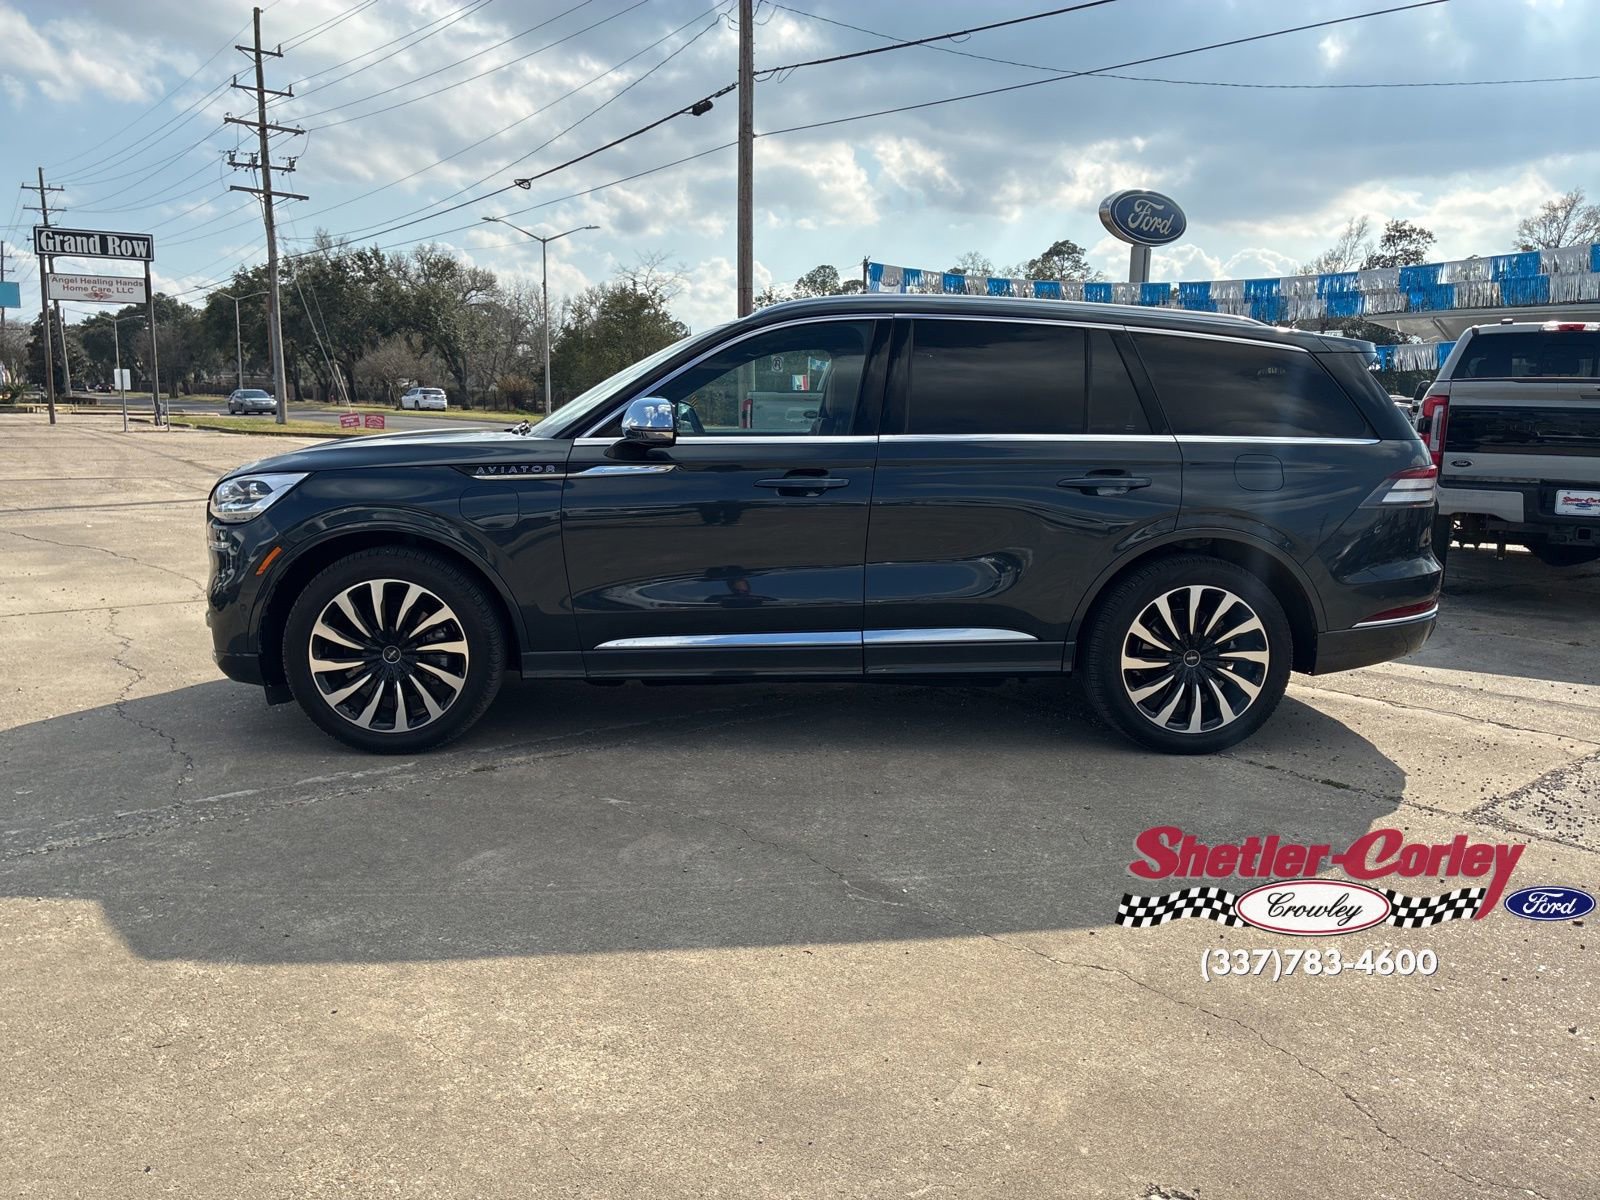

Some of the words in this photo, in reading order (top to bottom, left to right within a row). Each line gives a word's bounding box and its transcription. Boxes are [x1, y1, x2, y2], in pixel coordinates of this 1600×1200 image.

[1127, 199, 1175, 235] Ford
[40, 231, 101, 254] Grand
[106, 235, 148, 258] Row
[51, 276, 78, 285] Angel
[80, 278, 114, 287] Healing
[62, 284, 89, 292] Home
[91, 285, 114, 294] Care,
[116, 286, 135, 294] LLC
[476, 465, 556, 474] AVIATOR
